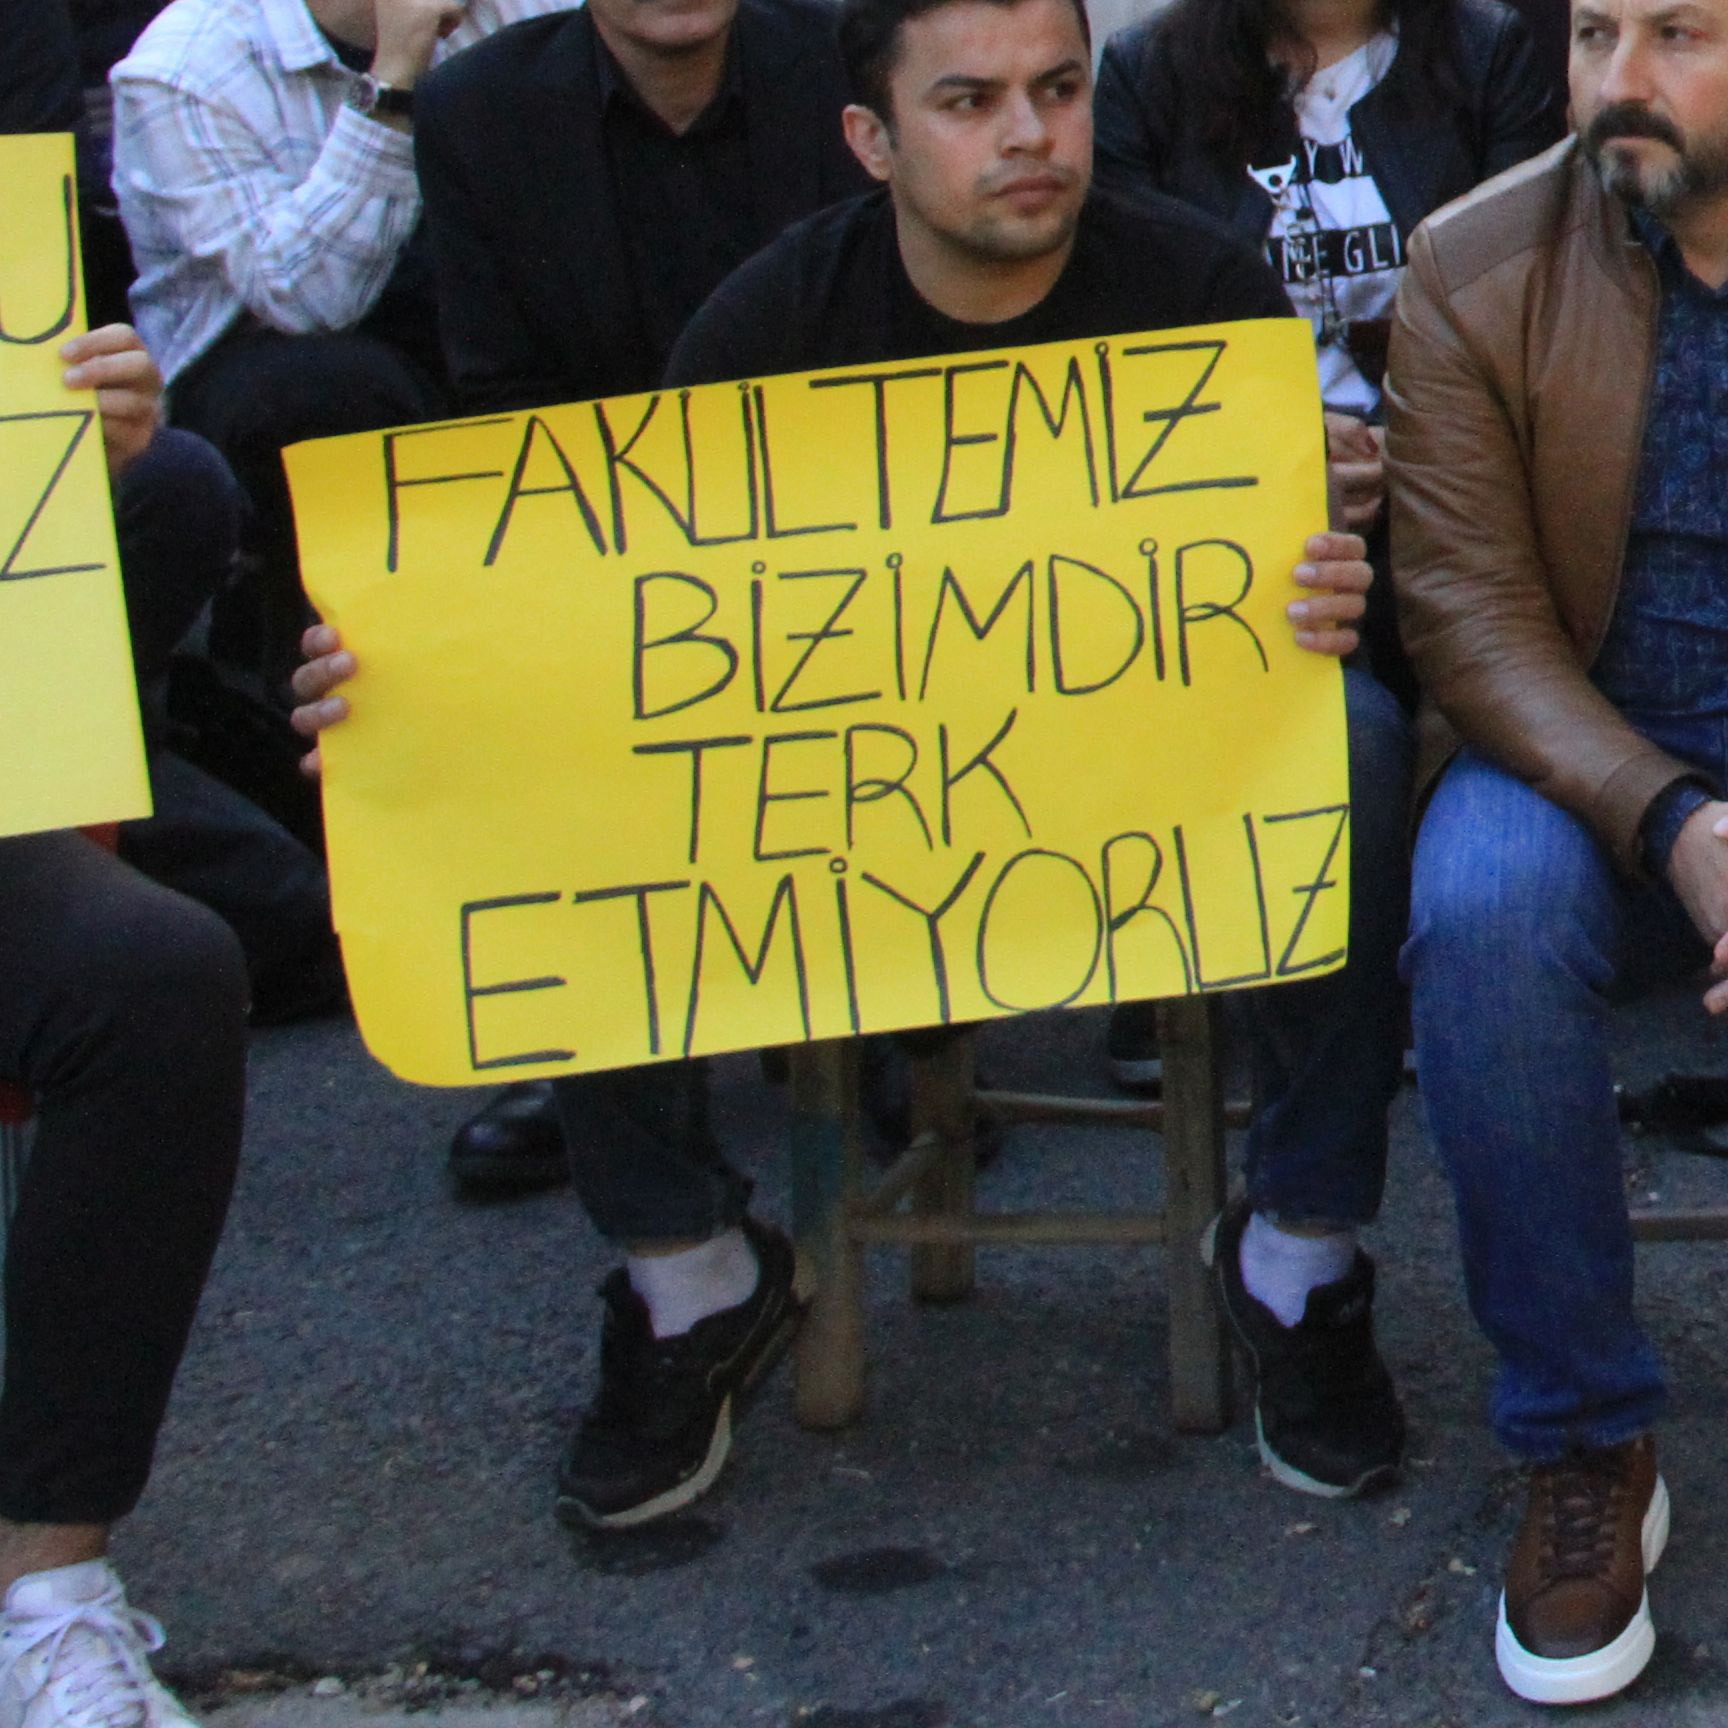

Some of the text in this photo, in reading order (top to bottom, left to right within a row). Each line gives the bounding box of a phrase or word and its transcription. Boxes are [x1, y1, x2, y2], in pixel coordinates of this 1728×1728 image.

[381, 338, 1261, 574] FAKÜLTEMİZ
[631, 536, 1270, 721] BİZİMDİR
[631, 707, 1033, 865] TERK
[460, 802, 1351, 1073] ETMİYORUZ
